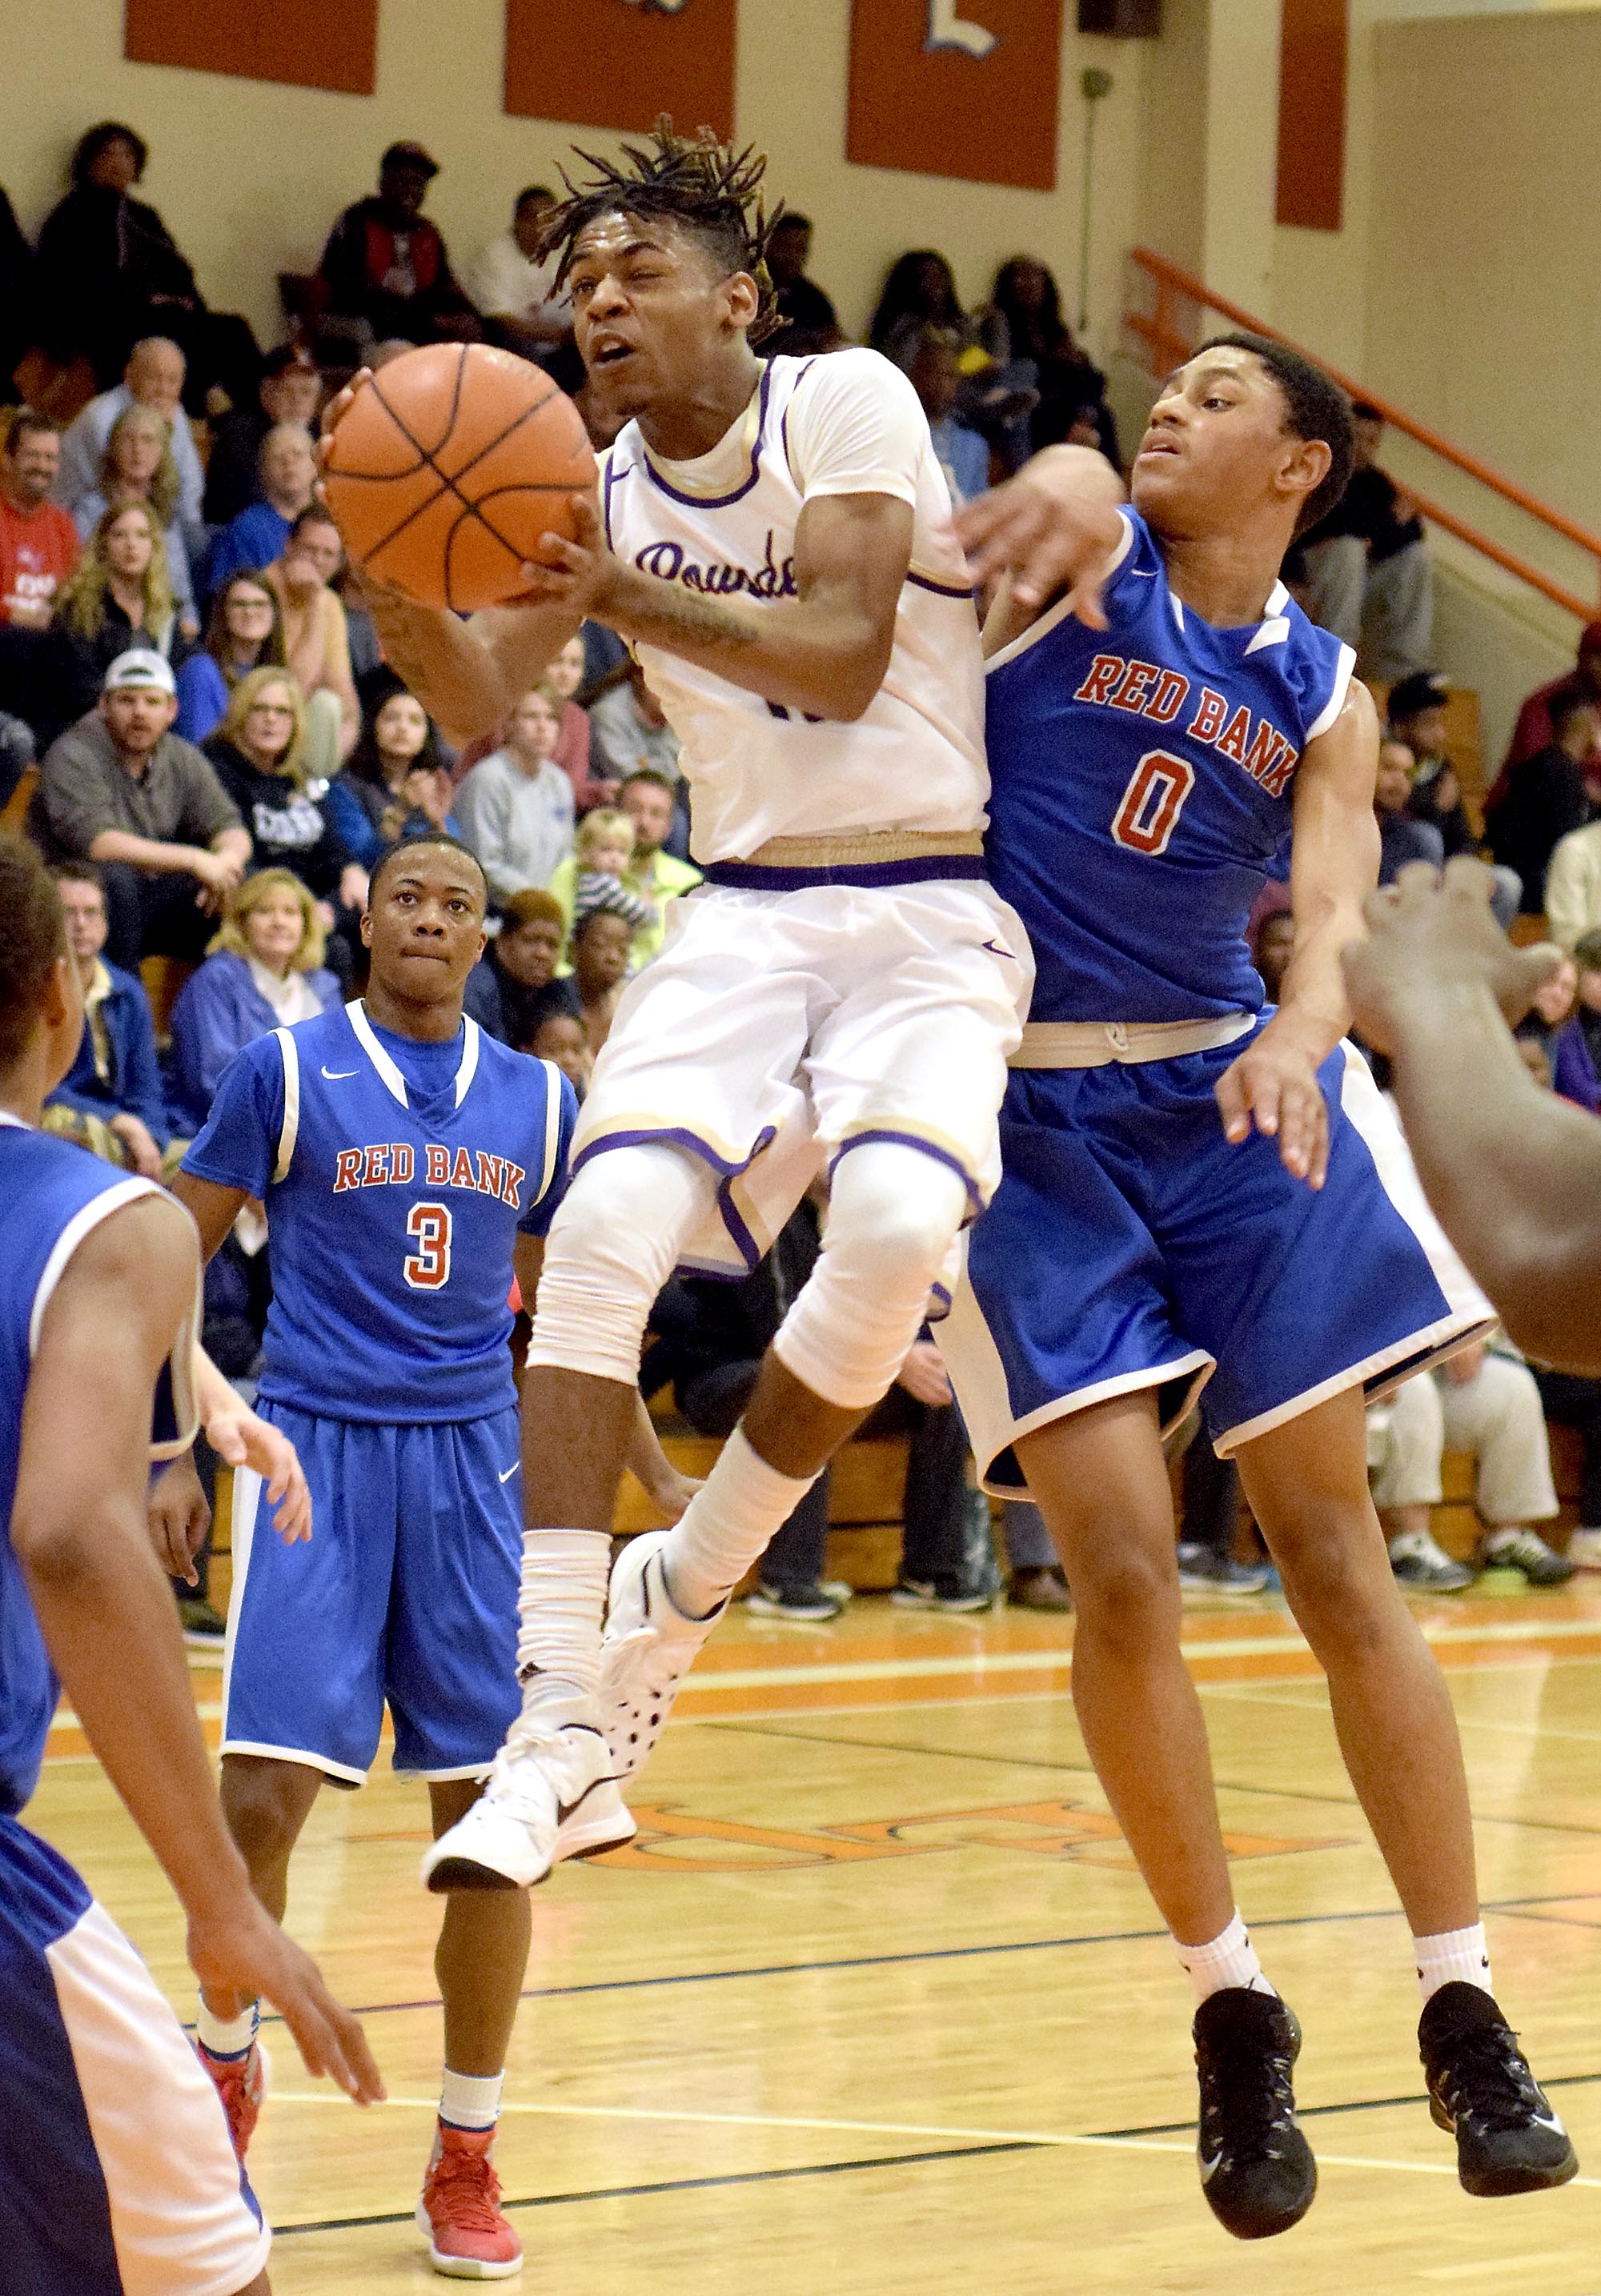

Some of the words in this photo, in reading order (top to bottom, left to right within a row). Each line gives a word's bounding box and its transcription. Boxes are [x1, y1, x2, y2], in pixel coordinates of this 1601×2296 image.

[636, 528, 798, 599] Pounde
[1073, 654, 1190, 723] RED
[1186, 687, 1298, 799] BANK
[1110, 748, 1195, 857] 0
[333, 1143, 415, 1193] RED
[425, 1144, 526, 1210] BANK
[403, 1201, 452, 1290] 3
